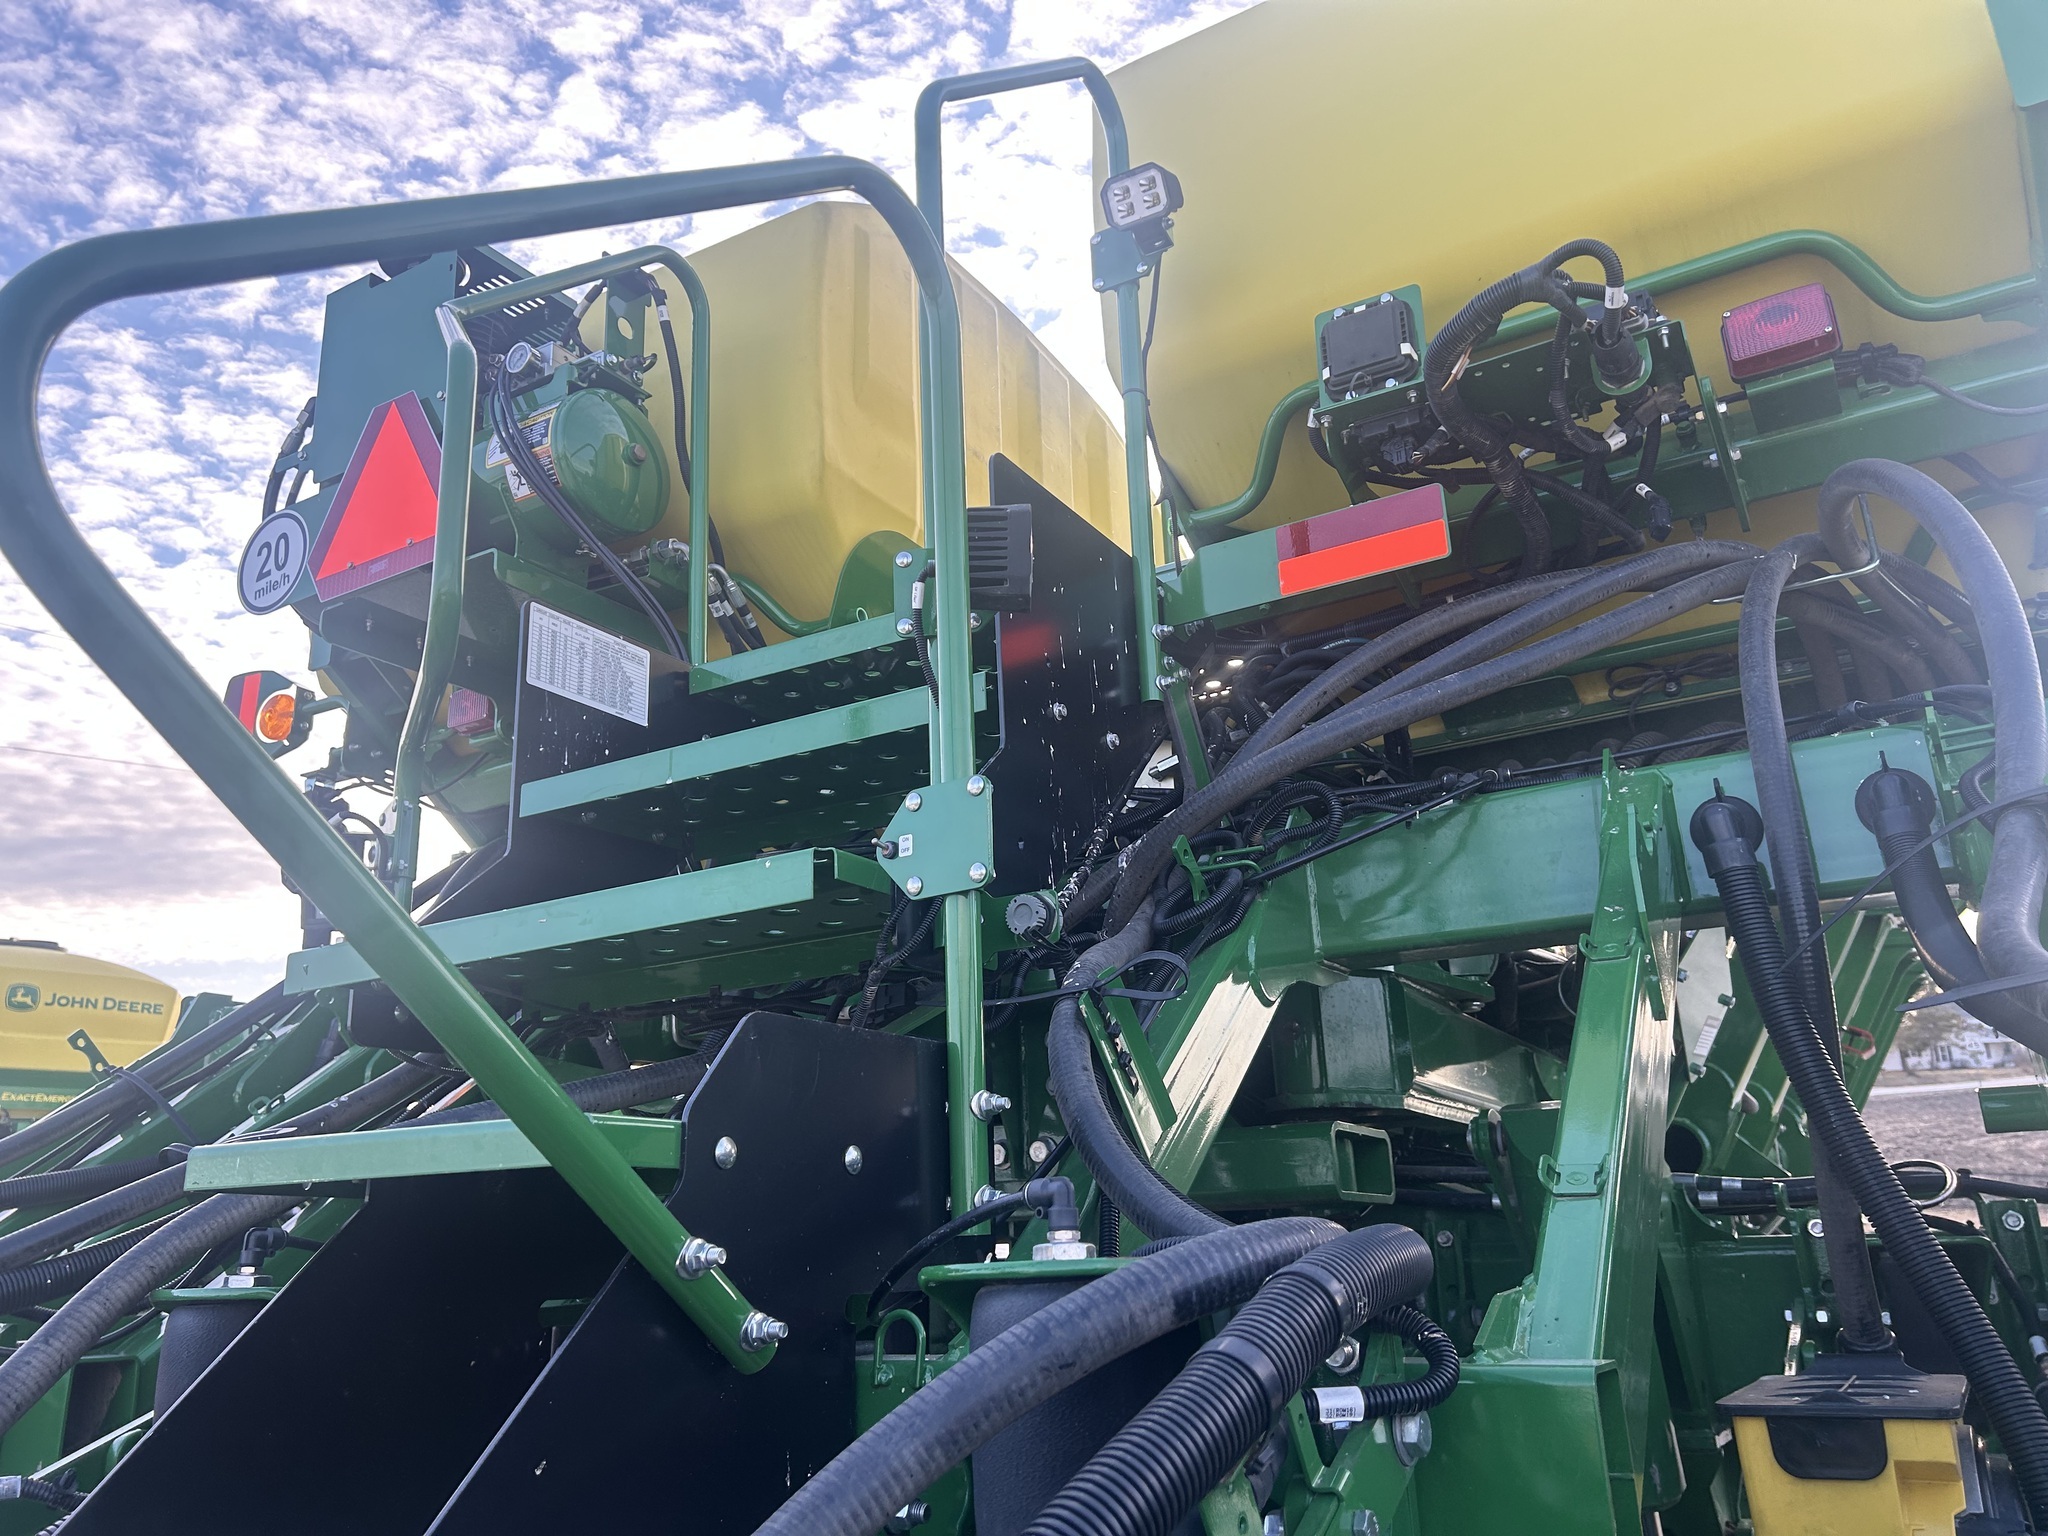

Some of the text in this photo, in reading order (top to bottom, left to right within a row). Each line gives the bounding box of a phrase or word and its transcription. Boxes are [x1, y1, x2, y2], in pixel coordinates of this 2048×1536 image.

[256, 533, 289, 582] 20
[254, 573, 290, 600] mile/h
[44, 993, 163, 1014] JOHN DEERE
